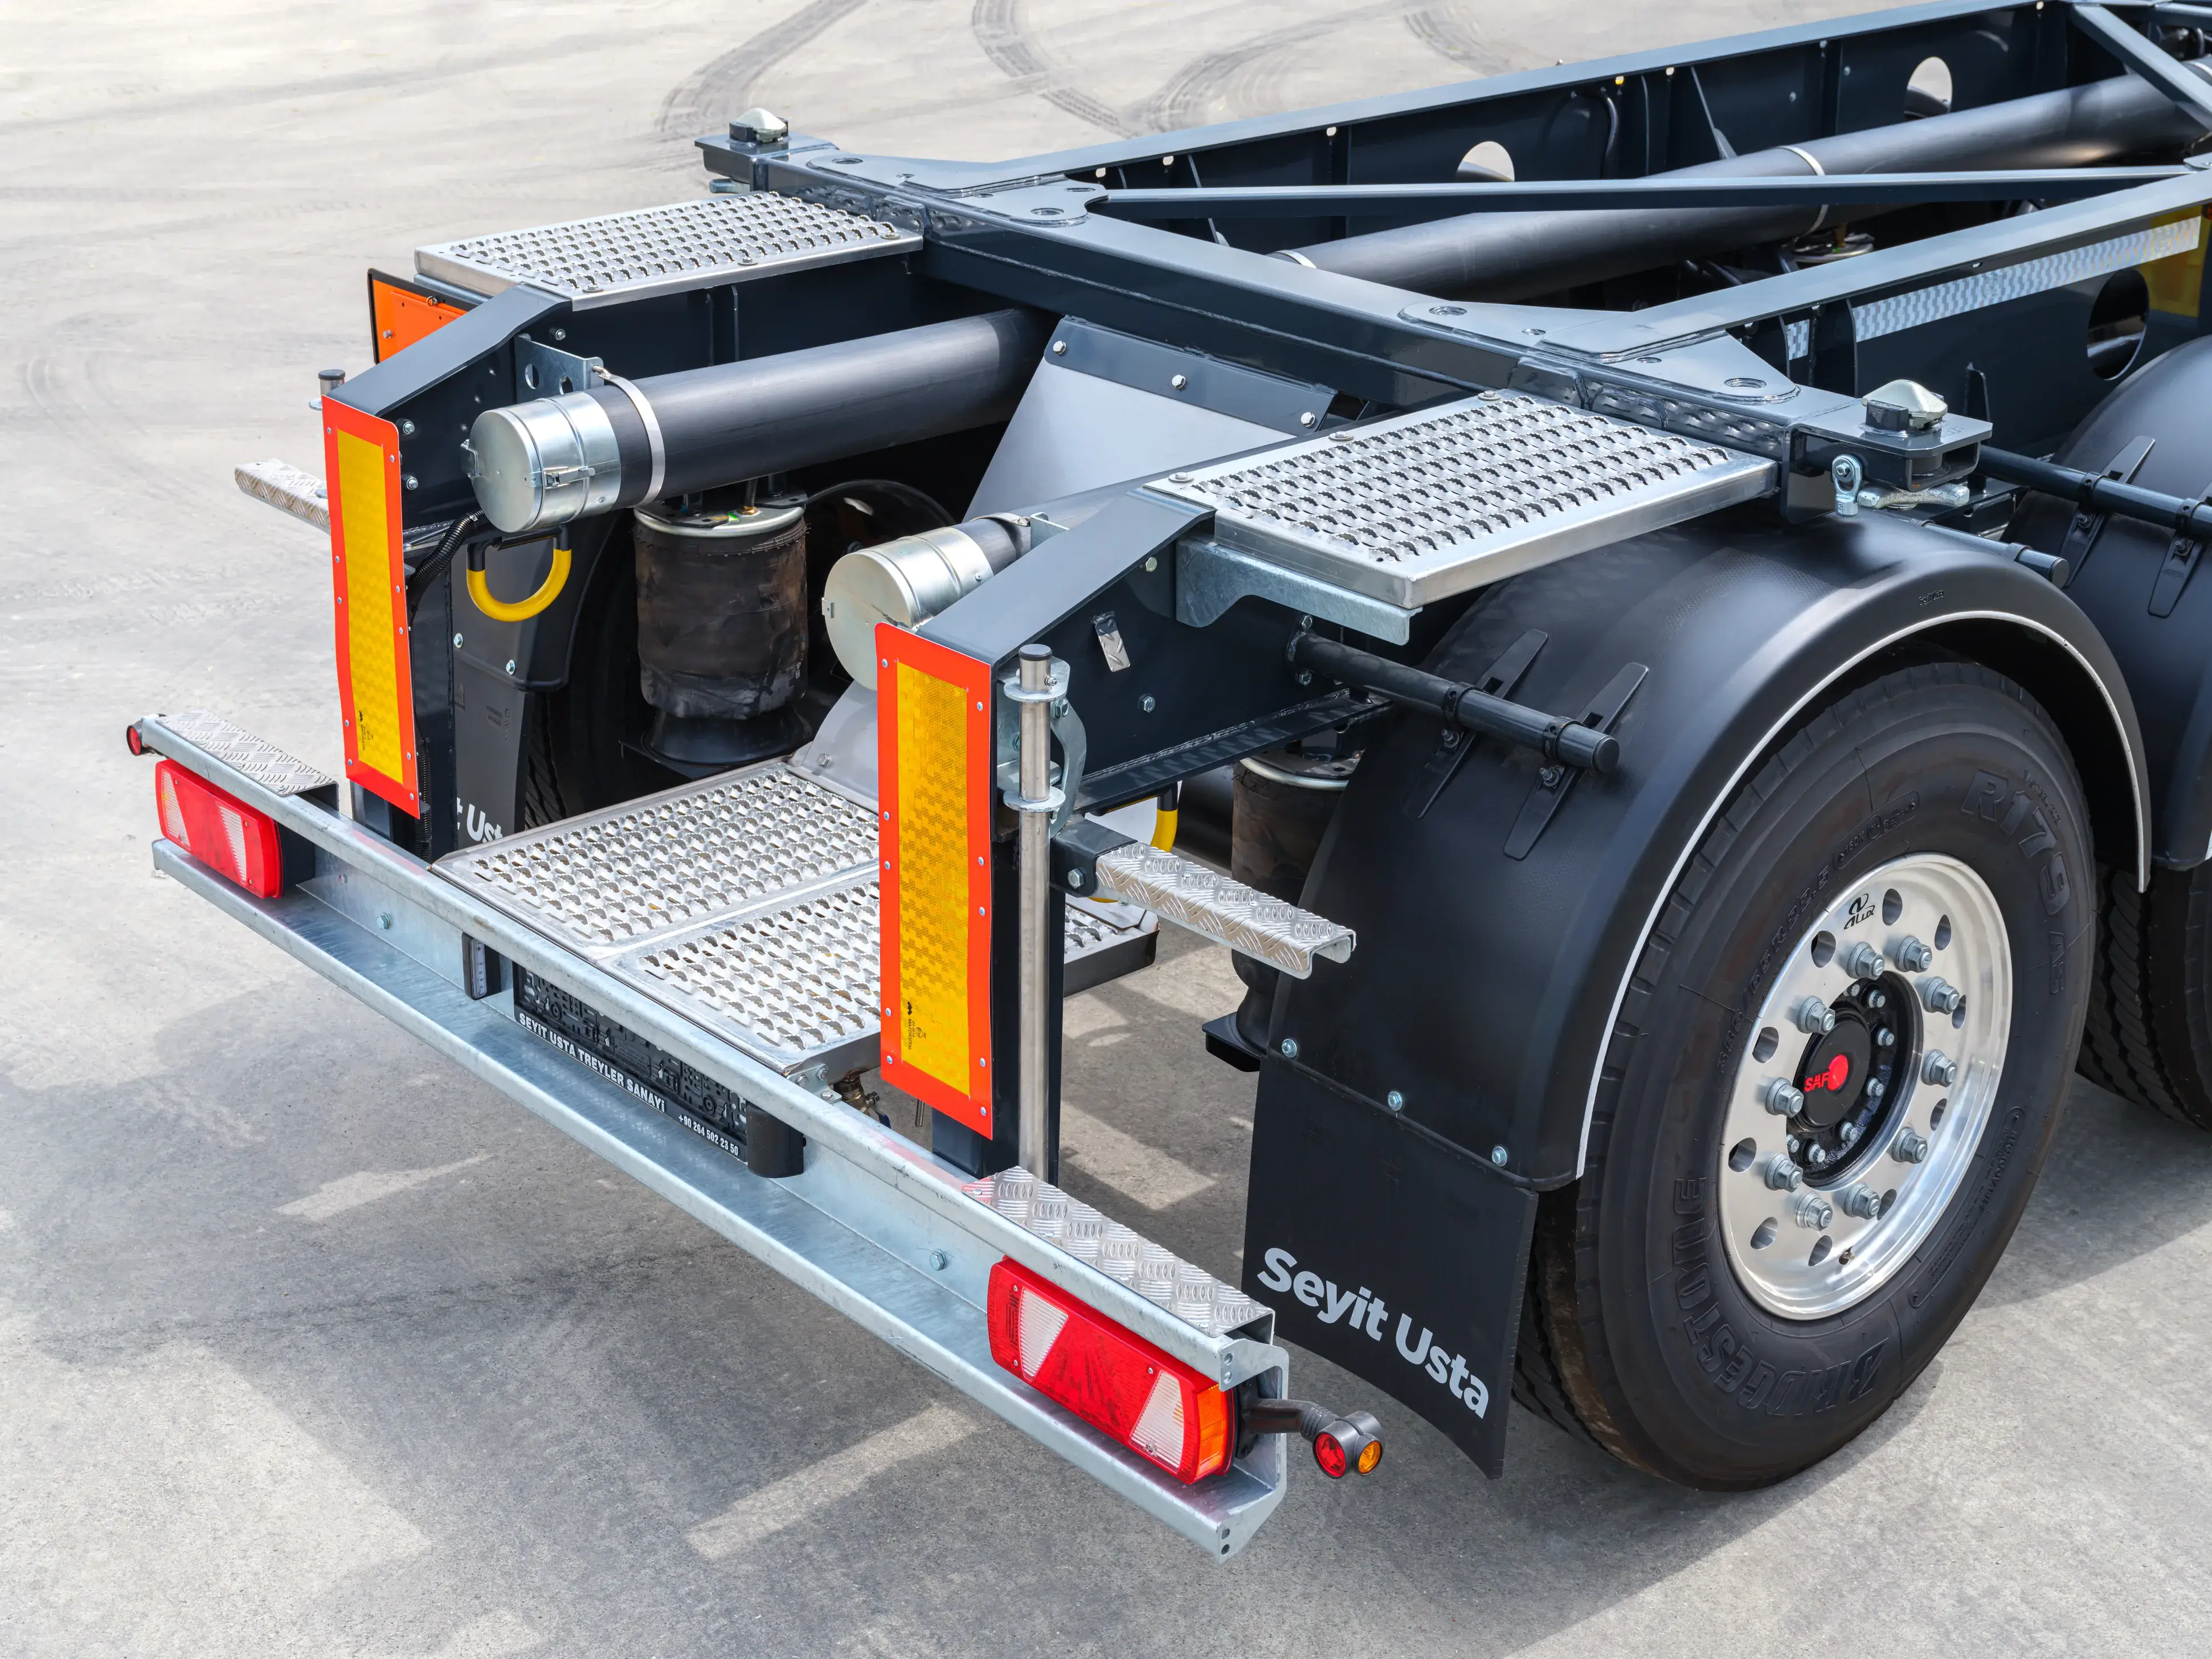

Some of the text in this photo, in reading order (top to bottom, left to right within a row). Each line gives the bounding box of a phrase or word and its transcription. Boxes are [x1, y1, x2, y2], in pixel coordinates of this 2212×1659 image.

[1960, 767, 2071, 916] R179
[550, 1031, 576, 1057] USTA
[578, 1048, 624, 1087] TREYLER
[1804, 1071, 1830, 1092] SAF
[678, 1114, 738, 1156] +90 264 502 23 50
[1257, 1247, 1489, 1419] Seyit Usta
[1643, 1176, 1890, 1417] BRIDGESTONE
